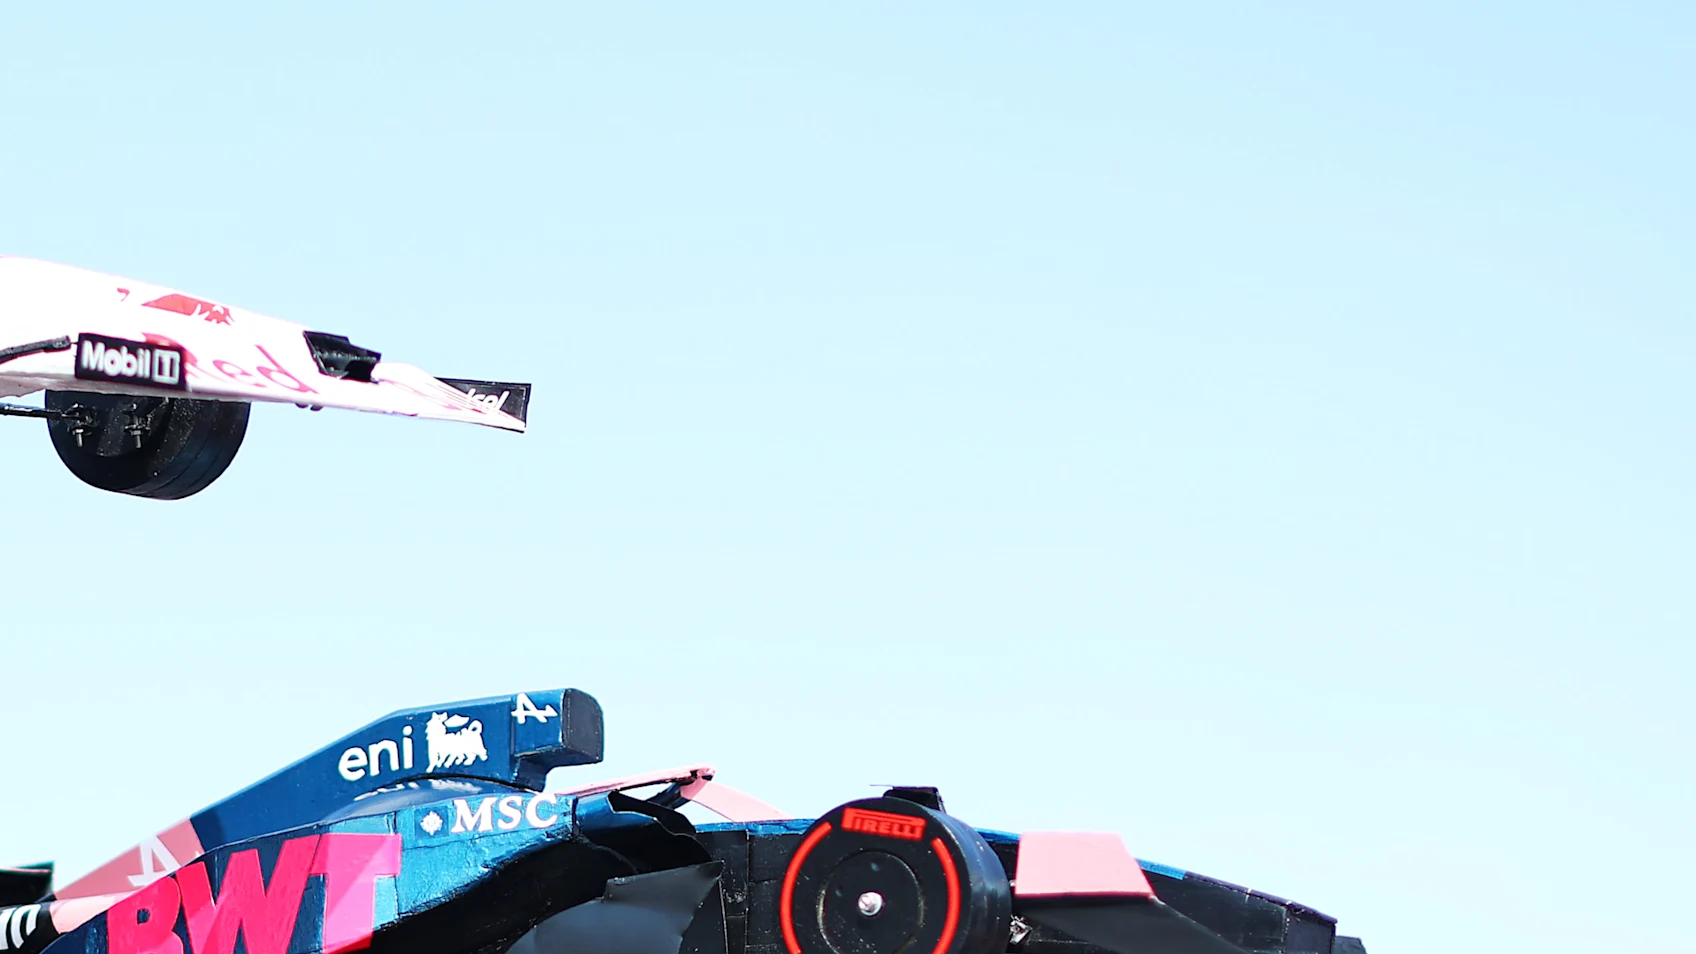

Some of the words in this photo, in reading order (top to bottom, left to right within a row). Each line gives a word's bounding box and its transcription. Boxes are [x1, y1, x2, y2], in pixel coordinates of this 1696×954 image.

[80, 340, 151, 380] Mobil
[337, 725, 414, 782] eni
[451, 792, 559, 835] MSC
[841, 807, 927, 842] PIRELLI
